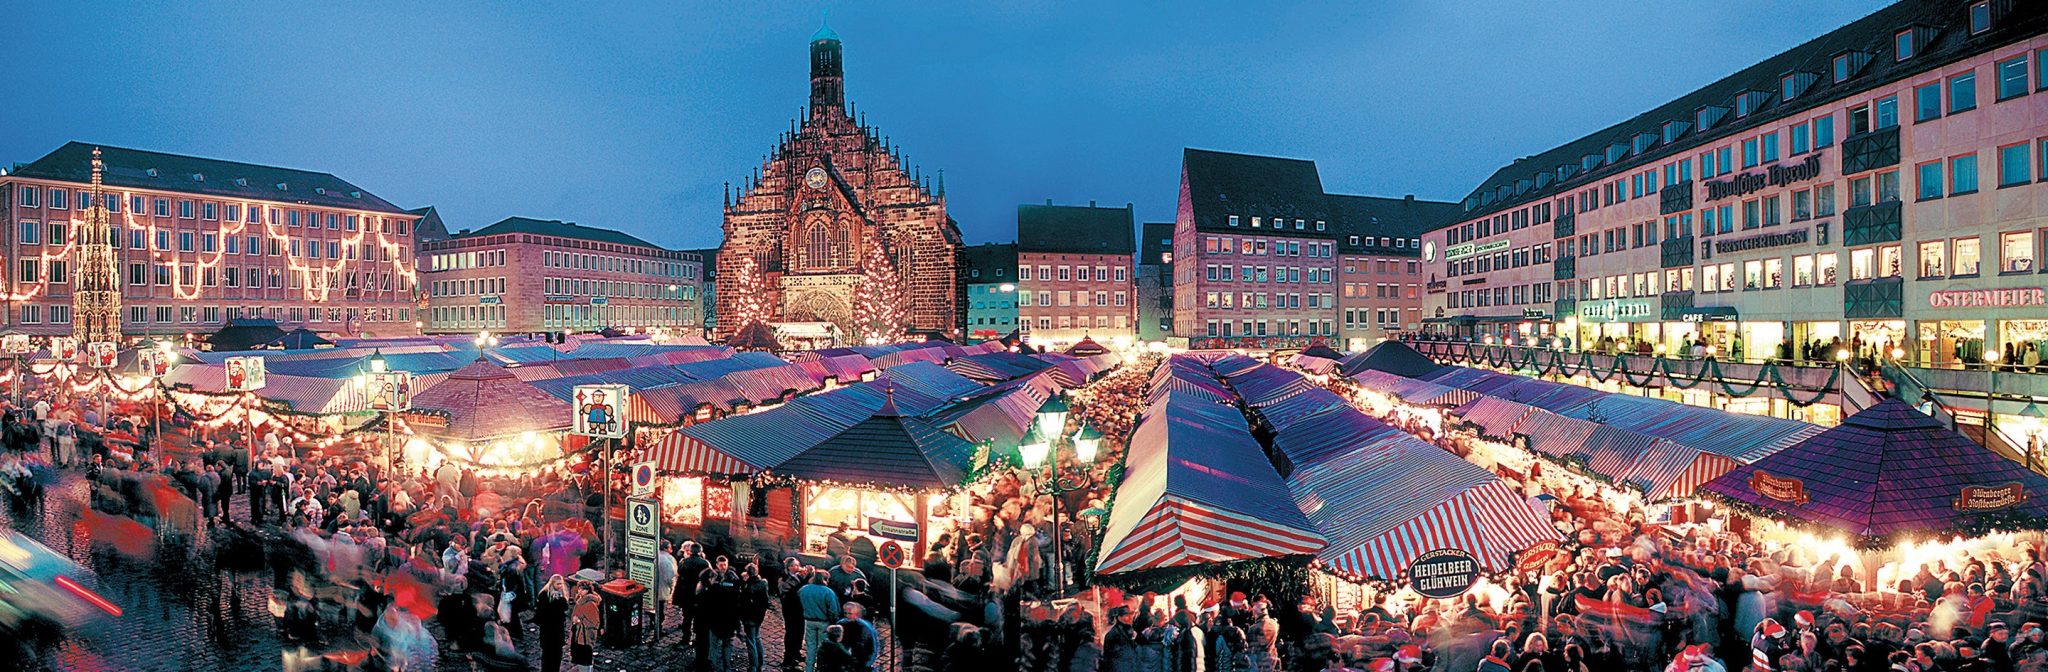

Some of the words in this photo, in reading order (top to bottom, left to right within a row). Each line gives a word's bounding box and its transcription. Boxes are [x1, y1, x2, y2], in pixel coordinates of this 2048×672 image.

[1715, 230, 1807, 254] VERSICHERUNGEN
[1929, 287, 2045, 308] OSTERMEIER
[1683, 313, 1704, 322] CAFE
[1972, 487, 2012, 499] Nürnberger
[635, 524, 648, 533] ZONE
[1414, 560, 1473, 578] HEIDELBEER
[1420, 574, 1469, 592] GLÜHWEIN
